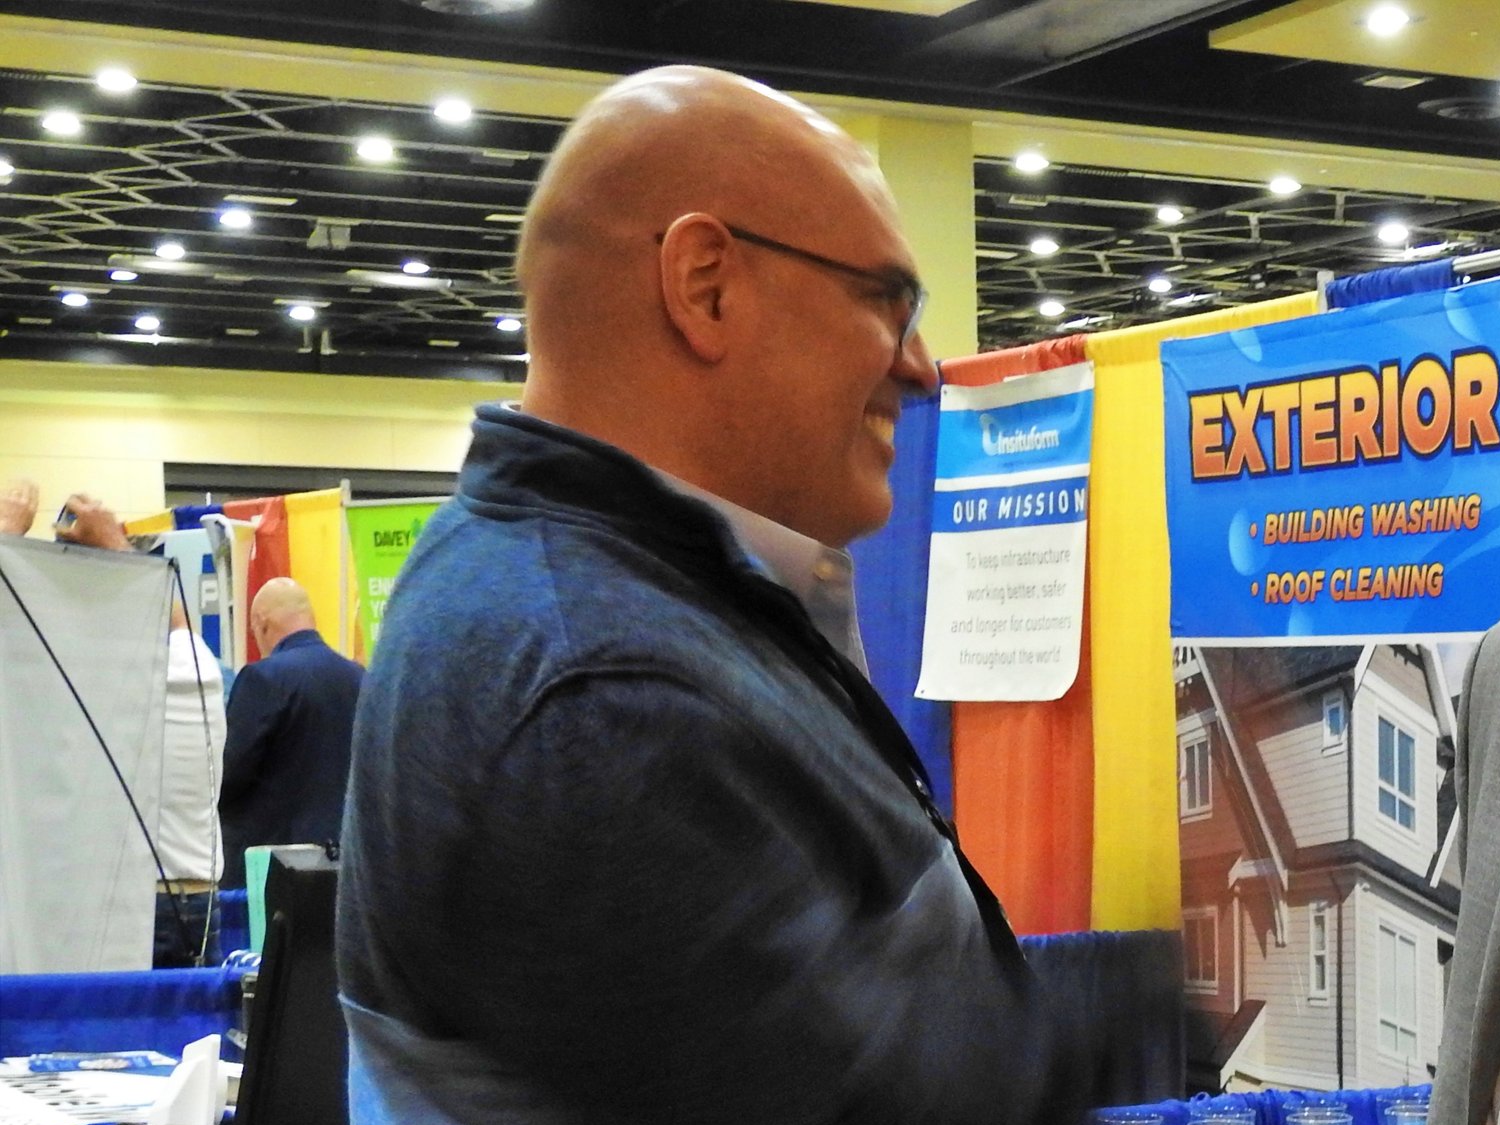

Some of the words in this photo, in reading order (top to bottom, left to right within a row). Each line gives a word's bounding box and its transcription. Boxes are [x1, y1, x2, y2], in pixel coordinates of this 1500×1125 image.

[998, 427, 1060, 455] Insituform
[953, 498, 987, 524] OUR
[997, 487, 1086, 521] MISSION
[1263, 504, 1365, 547] BUILDING
[1371, 494, 1482, 538] WASHING
[373, 530, 411, 548] DAVEY
[966, 551, 977, 570] To
[979, 551, 999, 572] keep
[1000, 546, 1071, 569] infrastructure
[966, 585, 1006, 605] working
[1041, 580, 1067, 600] safer
[1264, 570, 1325, 604] ROOF
[1329, 562, 1444, 602] CLEANING
[950, 615, 973, 634] and
[975, 613, 1008, 636] longer
[1010, 613, 1024, 631] for
[1025, 612, 1072, 632] customers
[959, 649, 1017, 670] throughout
[1018, 649, 1034, 665] the
[1035, 647, 1061, 665] world
